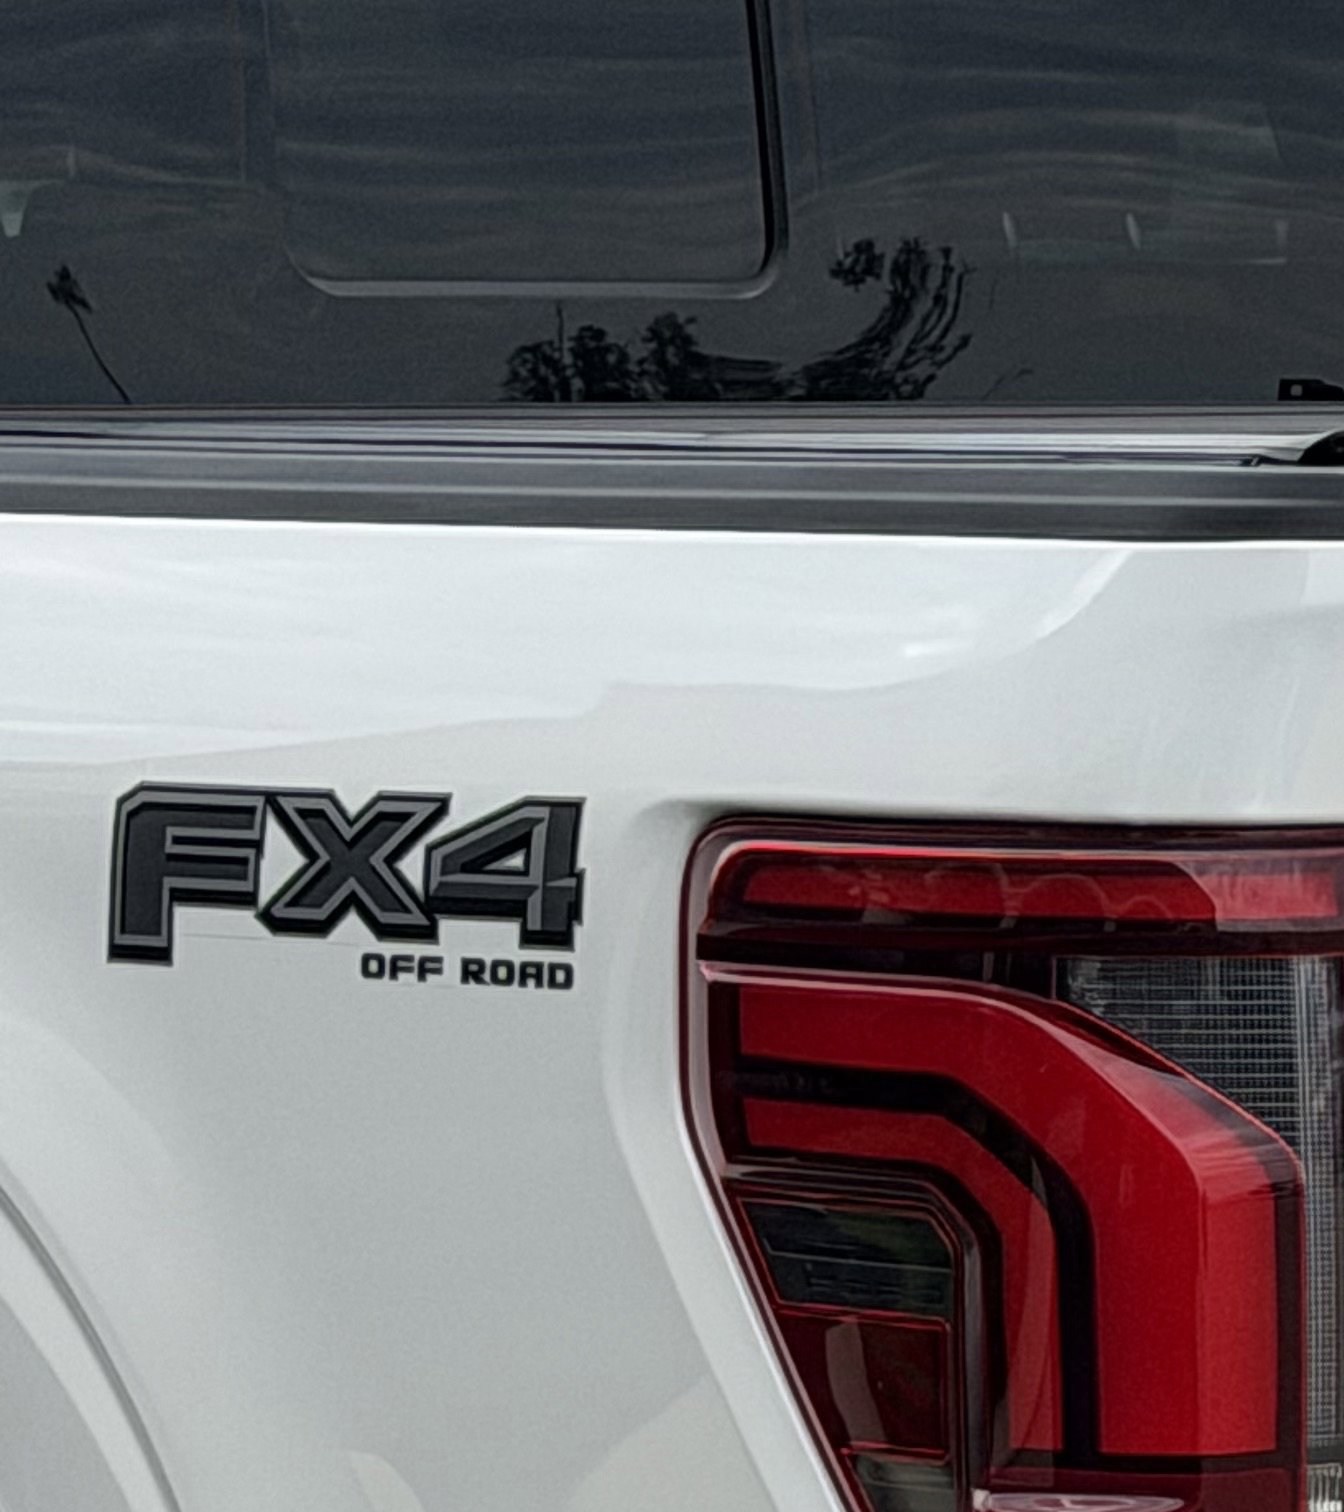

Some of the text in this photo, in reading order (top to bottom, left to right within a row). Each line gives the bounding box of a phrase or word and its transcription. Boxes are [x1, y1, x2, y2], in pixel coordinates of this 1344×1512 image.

[107, 781, 587, 965] FX4
[361, 952, 575, 991] OFF ROAD
